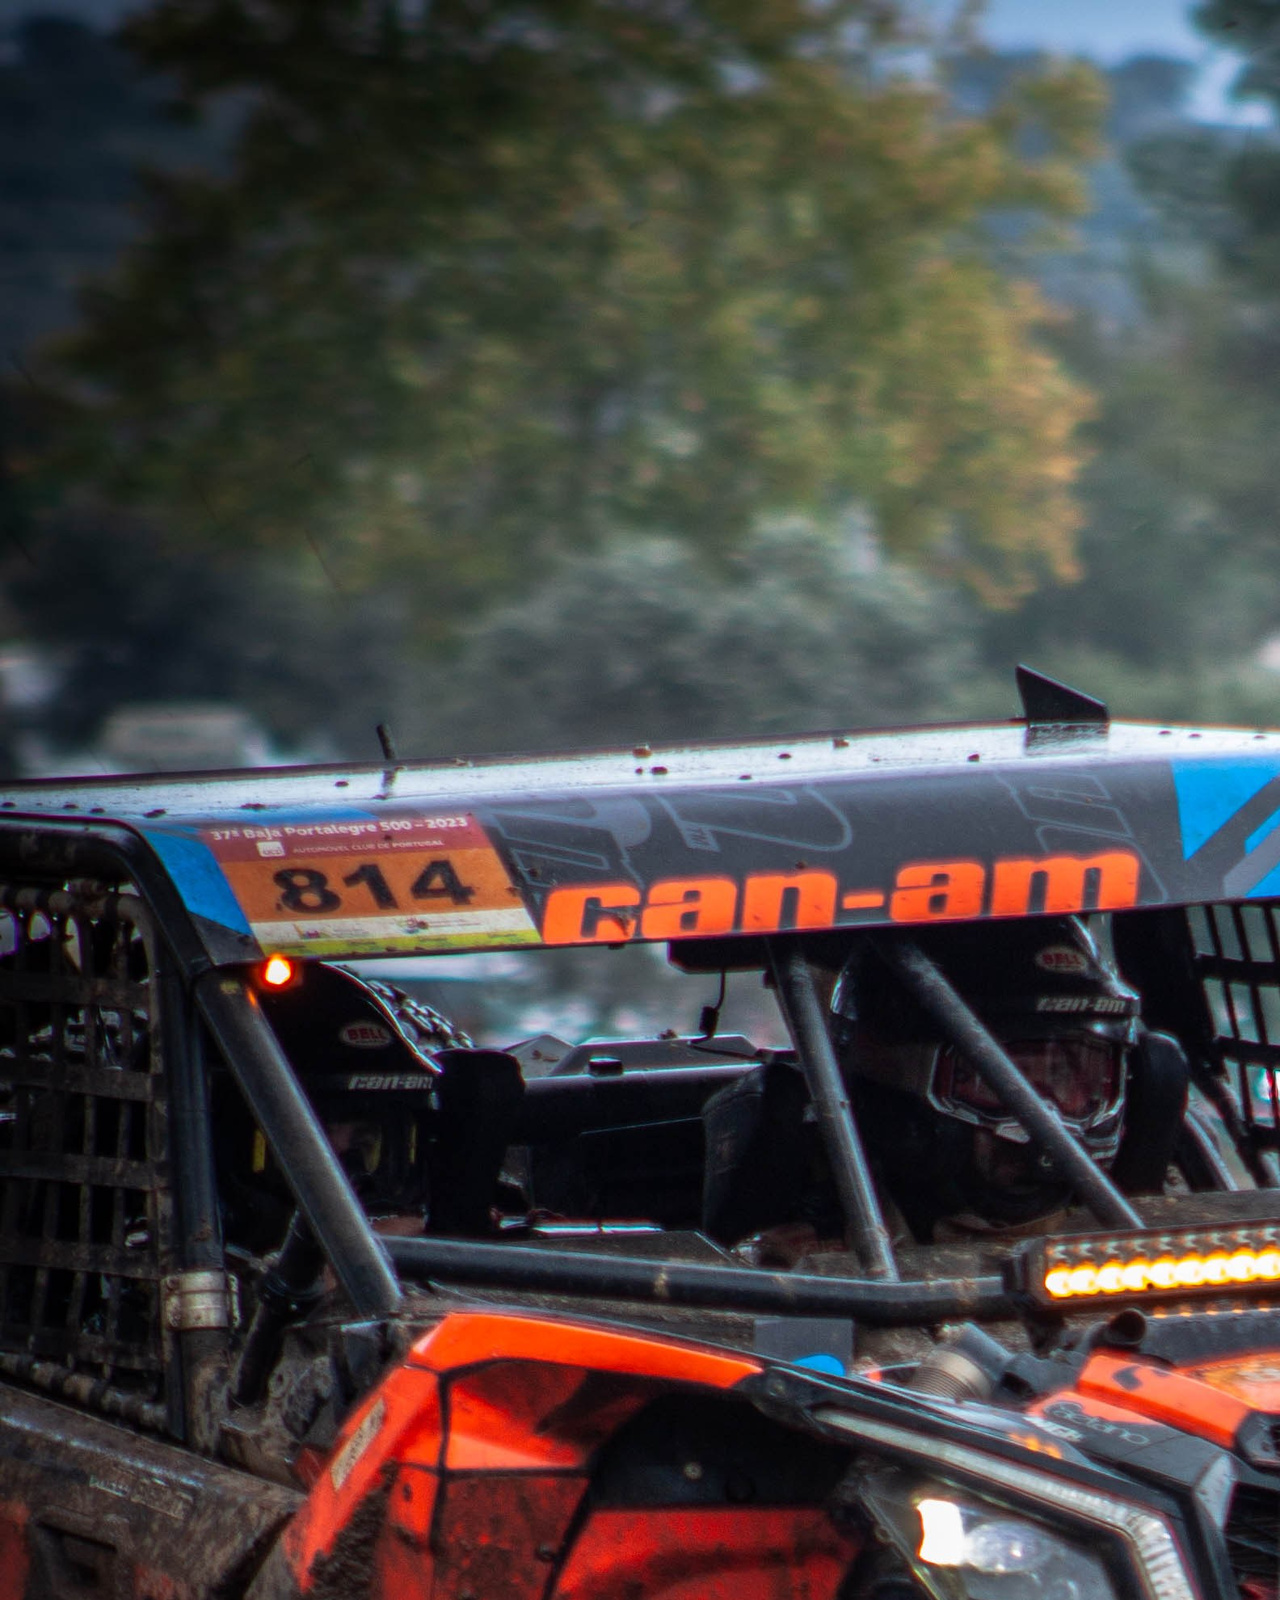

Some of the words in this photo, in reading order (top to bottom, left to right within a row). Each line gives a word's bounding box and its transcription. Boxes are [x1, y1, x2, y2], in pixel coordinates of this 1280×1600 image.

[242, 828, 283, 841] Baja
[283, 823, 377, 836] Portalegre
[380, 820, 412, 832] 500
[425, 817, 468, 829] 2023
[392, 840, 444, 848] PORTUGAL
[272, 860, 475, 914] 814
[542, 849, 1140, 944] can-am
[1041, 953, 1081, 966] BELL
[1036, 996, 1125, 1014] can-am
[346, 1027, 388, 1041] BELL
